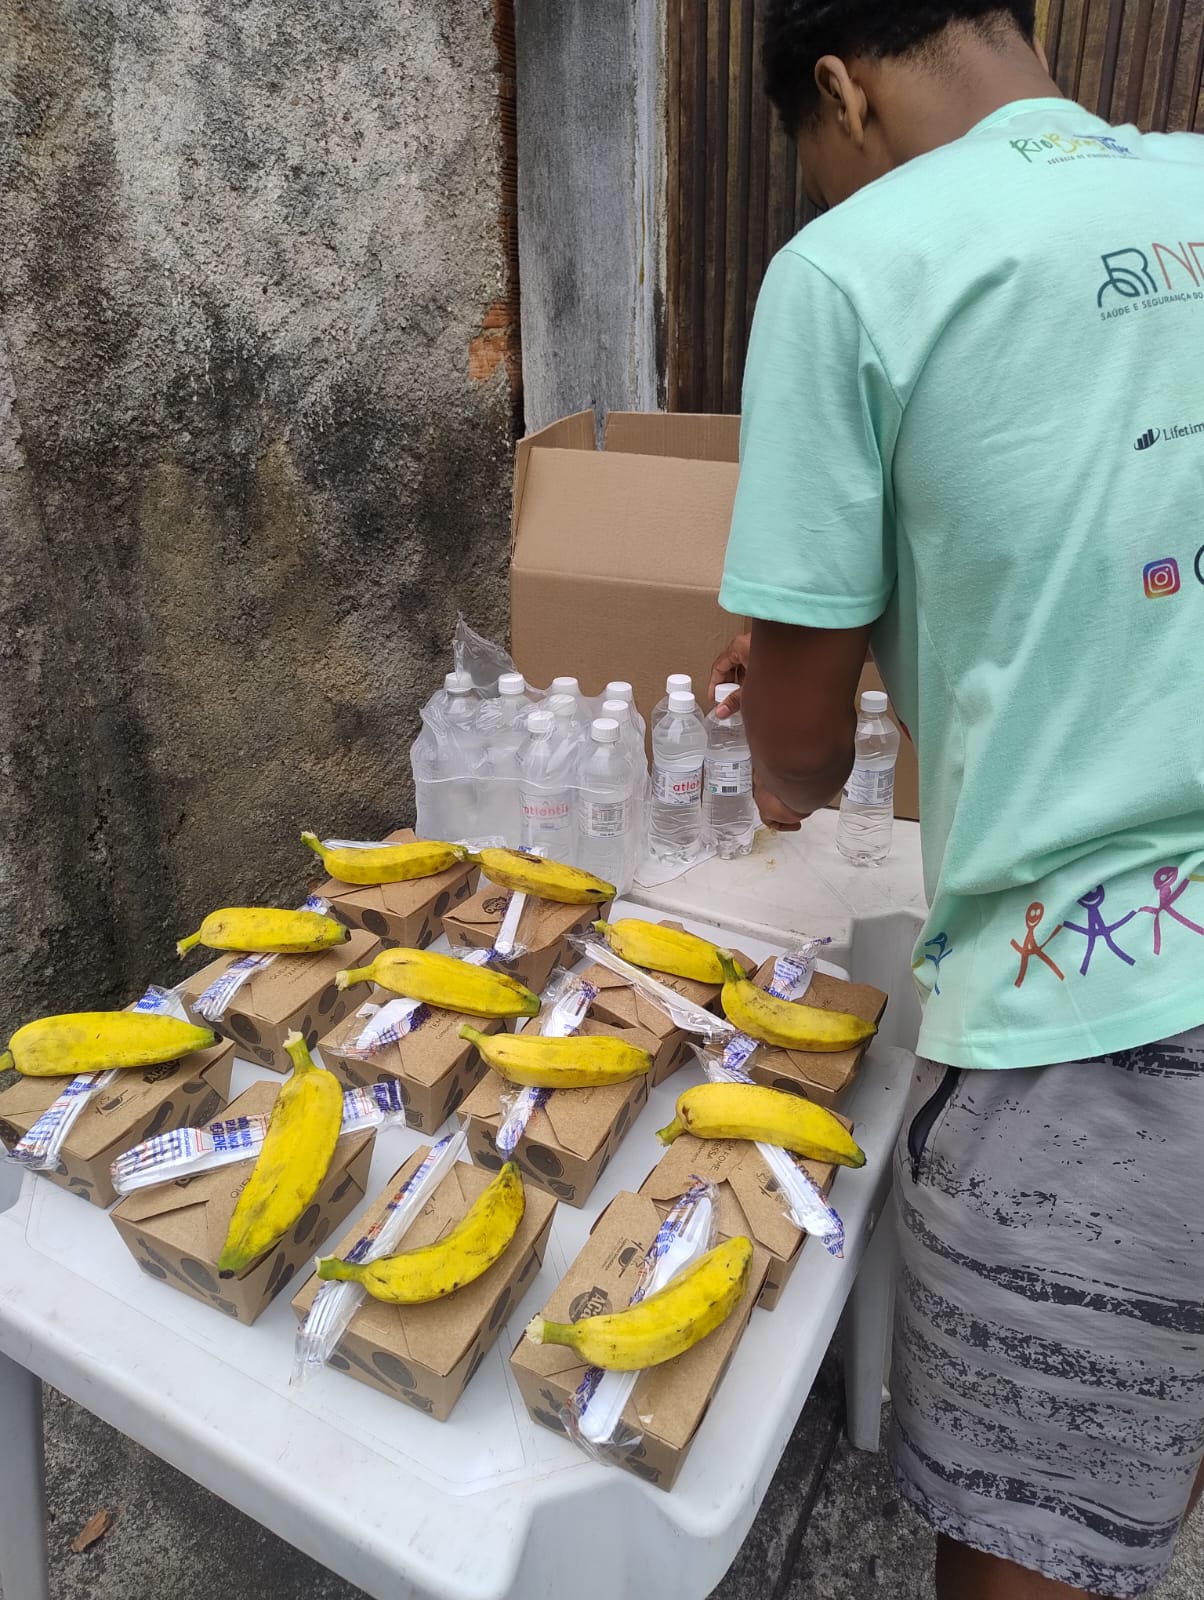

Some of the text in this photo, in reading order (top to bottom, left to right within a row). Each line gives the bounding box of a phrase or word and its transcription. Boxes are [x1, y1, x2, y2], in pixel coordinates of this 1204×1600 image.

[1100, 305, 1131, 321] SAÚDE
[1132, 302, 1139, 311] E
[1141, 293, 1191, 309] SEGURANÇA
[711, 1151, 729, 1171] FOME
